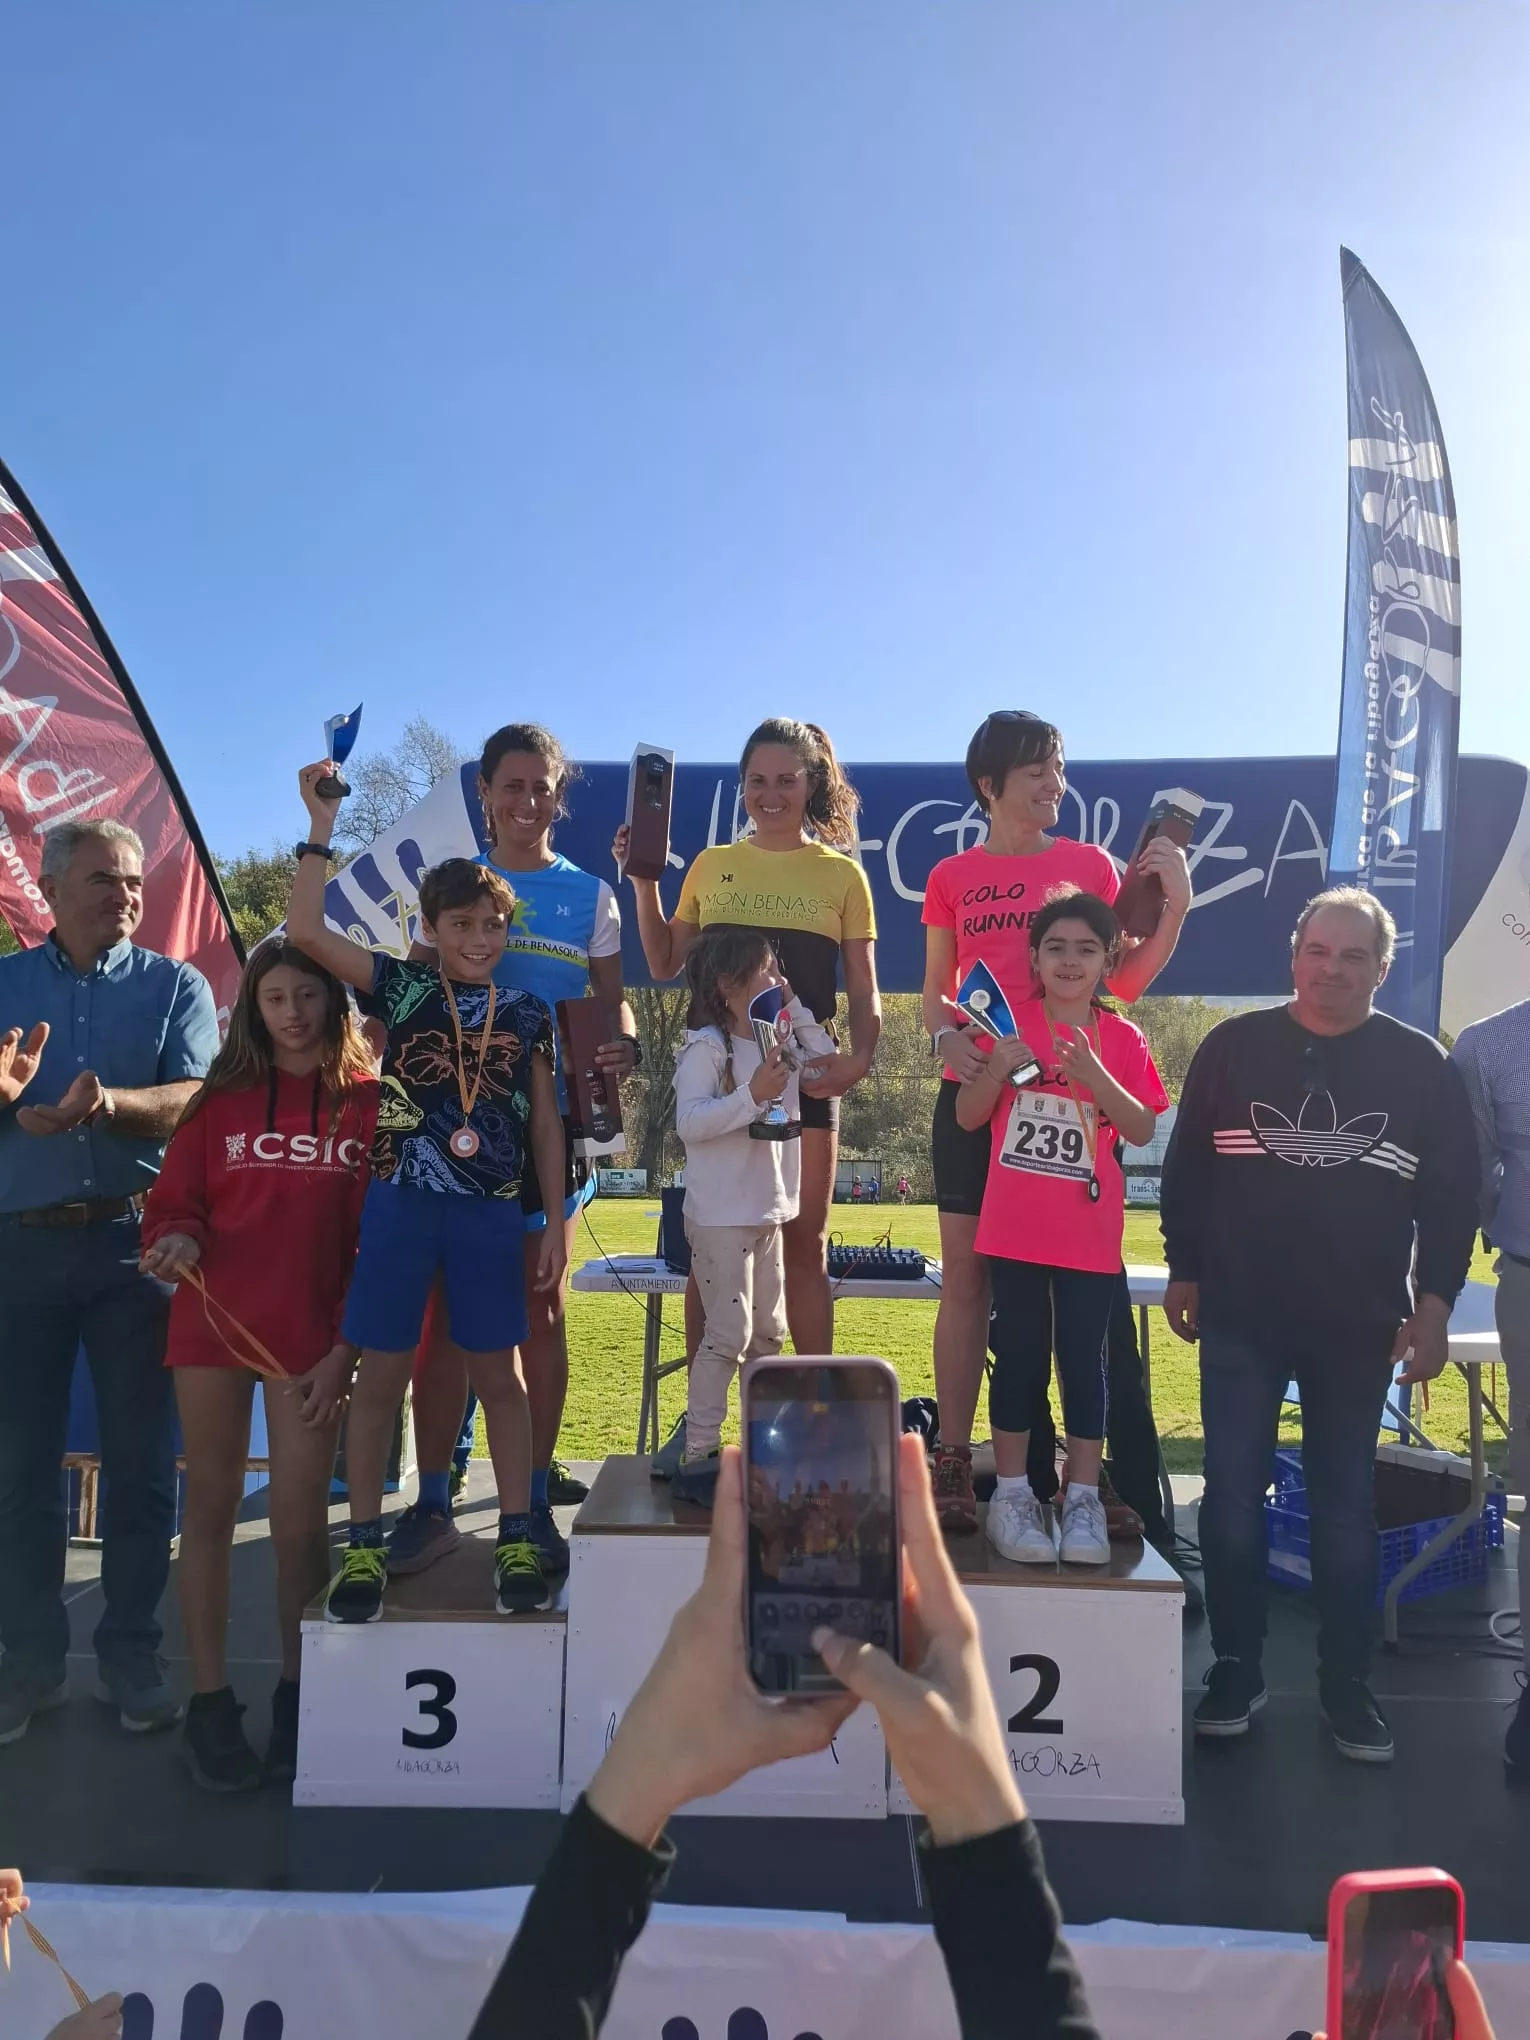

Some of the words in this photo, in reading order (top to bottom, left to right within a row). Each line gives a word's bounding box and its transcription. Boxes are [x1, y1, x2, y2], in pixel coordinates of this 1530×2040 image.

[705, 892, 748, 907] MON
[963, 883, 1025, 906] COLO
[964, 911, 1038, 937] RUNNE
[515, 940, 528, 949] DE
[253, 1132, 365, 1167] CSIC
[1013, 1120, 1084, 1164] 239
[402, 1668, 457, 1750] 3
[1007, 1653, 1064, 1735] 2
[1008, 1745, 1101, 1780] AGORZA
